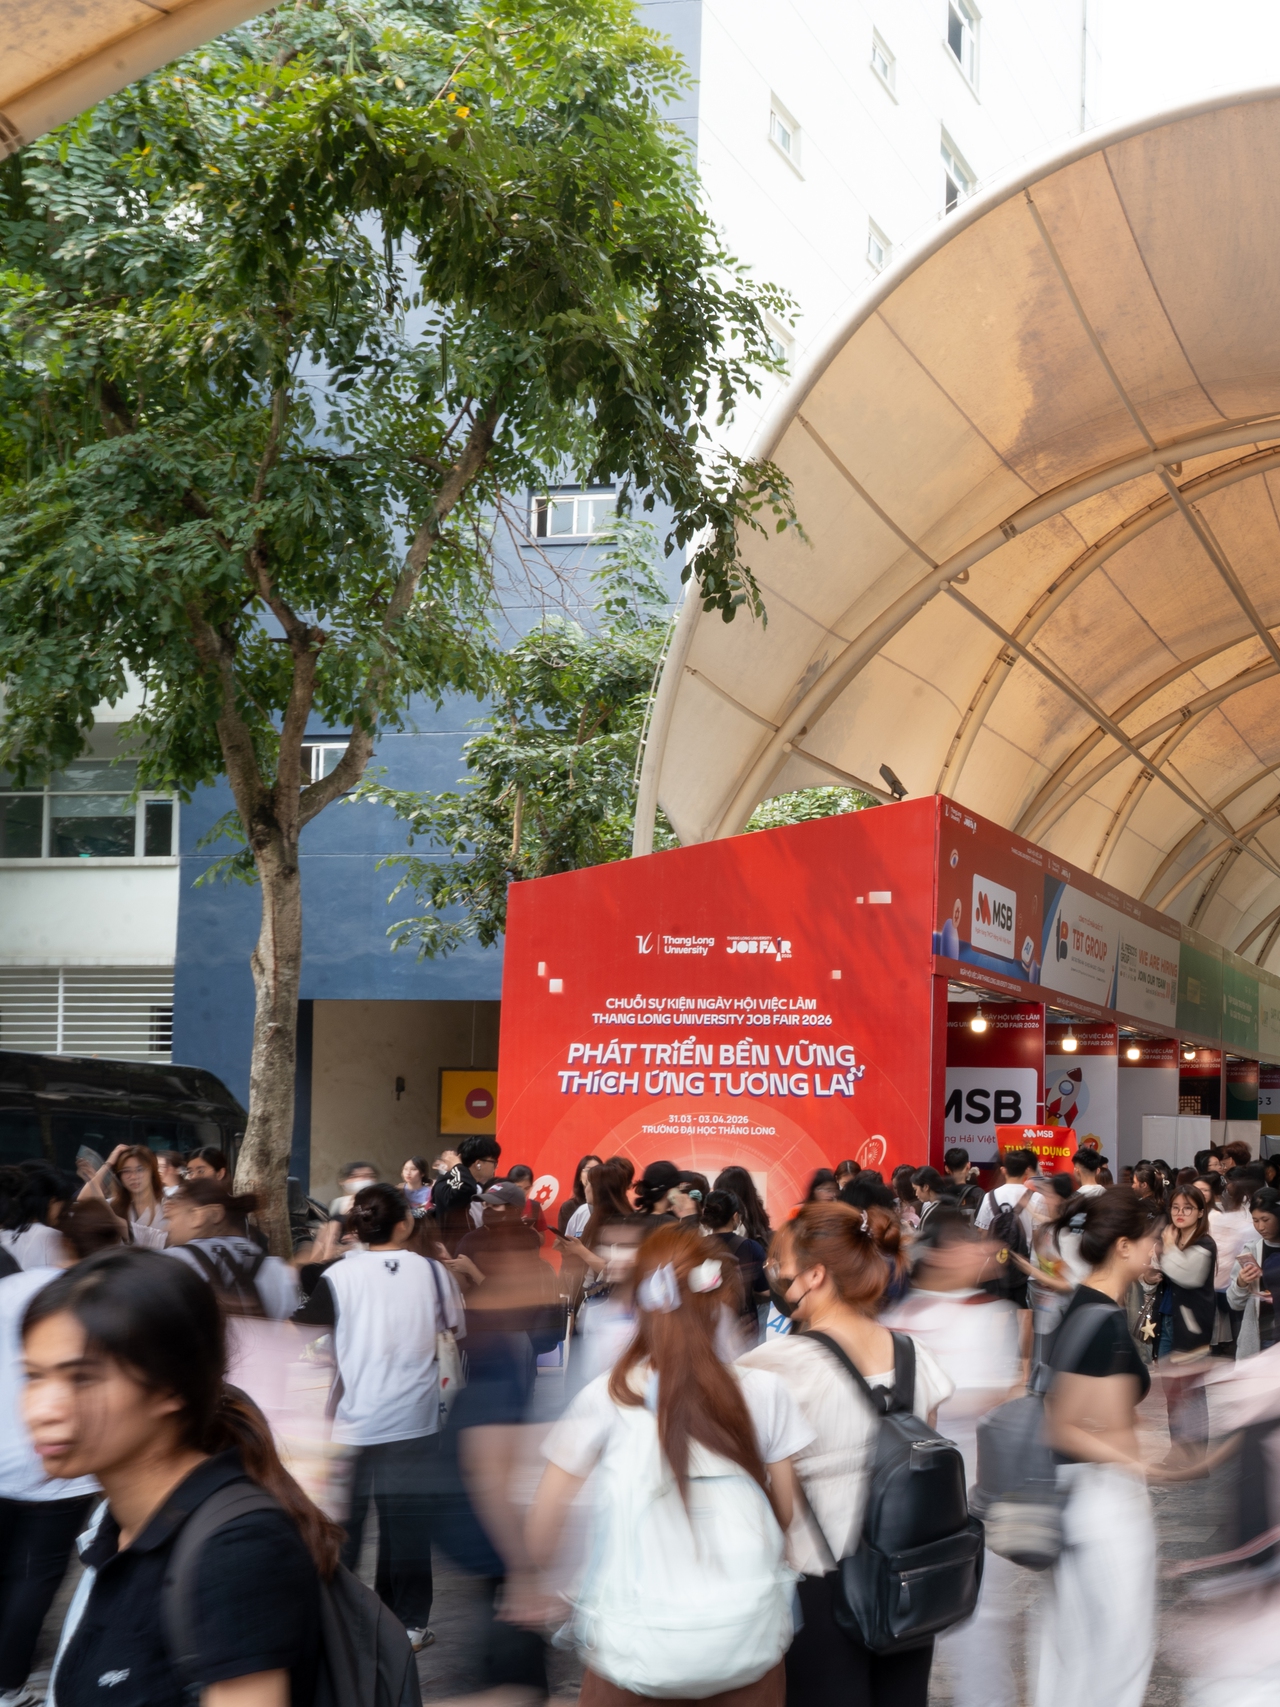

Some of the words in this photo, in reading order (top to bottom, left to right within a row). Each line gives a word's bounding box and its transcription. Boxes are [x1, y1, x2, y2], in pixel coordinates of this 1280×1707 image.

[993, 900, 1012, 931] MSB
[663, 936, 691, 946] Thang
[693, 936, 715, 946] Long
[726, 941, 758, 954] JOB
[1072, 928, 1084, 952] TBT
[1085, 934, 1107, 961] GROUP
[664, 946, 708, 956] University
[1138, 949, 1148, 966] WE
[1149, 954, 1160, 970] ARE
[1138, 970, 1146, 983] JOIN
[1147, 974, 1155, 986] OUR
[606, 994, 646, 1010] CHUỖI
[648, 998, 666, 1011] SỰ
[667, 996, 694, 1012] KIỆN
[698, 996, 730, 1009] NGÀY
[734, 998, 756, 1012] HỘI
[759, 998, 786, 1012] VIỆC
[789, 997, 816, 1010] LÀM
[592, 1013, 635, 1026] THANG
[638, 1013, 671, 1026] LONG
[673, 1013, 744, 1026] UNIVERSITY
[746, 1013, 771, 1026] JOB
[773, 1013, 800, 1026] FAIR
[802, 1013, 832, 1026] 2026
[567, 1038, 637, 1066] PHÁT
[719, 1037, 769, 1066] BỀN
[775, 1040, 856, 1066] VỮNG
[558, 1069, 638, 1093] THÍCH
[644, 1069, 704, 1094] ỨNG
[710, 1071, 808, 1095] TƯƠNG
[815, 1067, 862, 1096] LAI
[1266, 1097, 1271, 1105] 3
[668, 1115, 692, 1124] 31.03
[698, 1115, 749, 1124] 03.04.2026
[642, 1124, 679, 1135] TRƯỜNG
[680, 1125, 695, 1136] ĐẠI
[697, 1126, 716, 1136] HỌC
[718, 1124, 749, 1135] THĂNG
[751, 1126, 775, 1135] LONG
[1036, 1130, 1054, 1138] MSB
[959, 1134, 974, 1142] Hải
[977, 1135, 995, 1144] Việt
[1043, 1146, 1070, 1158] DỤNG
